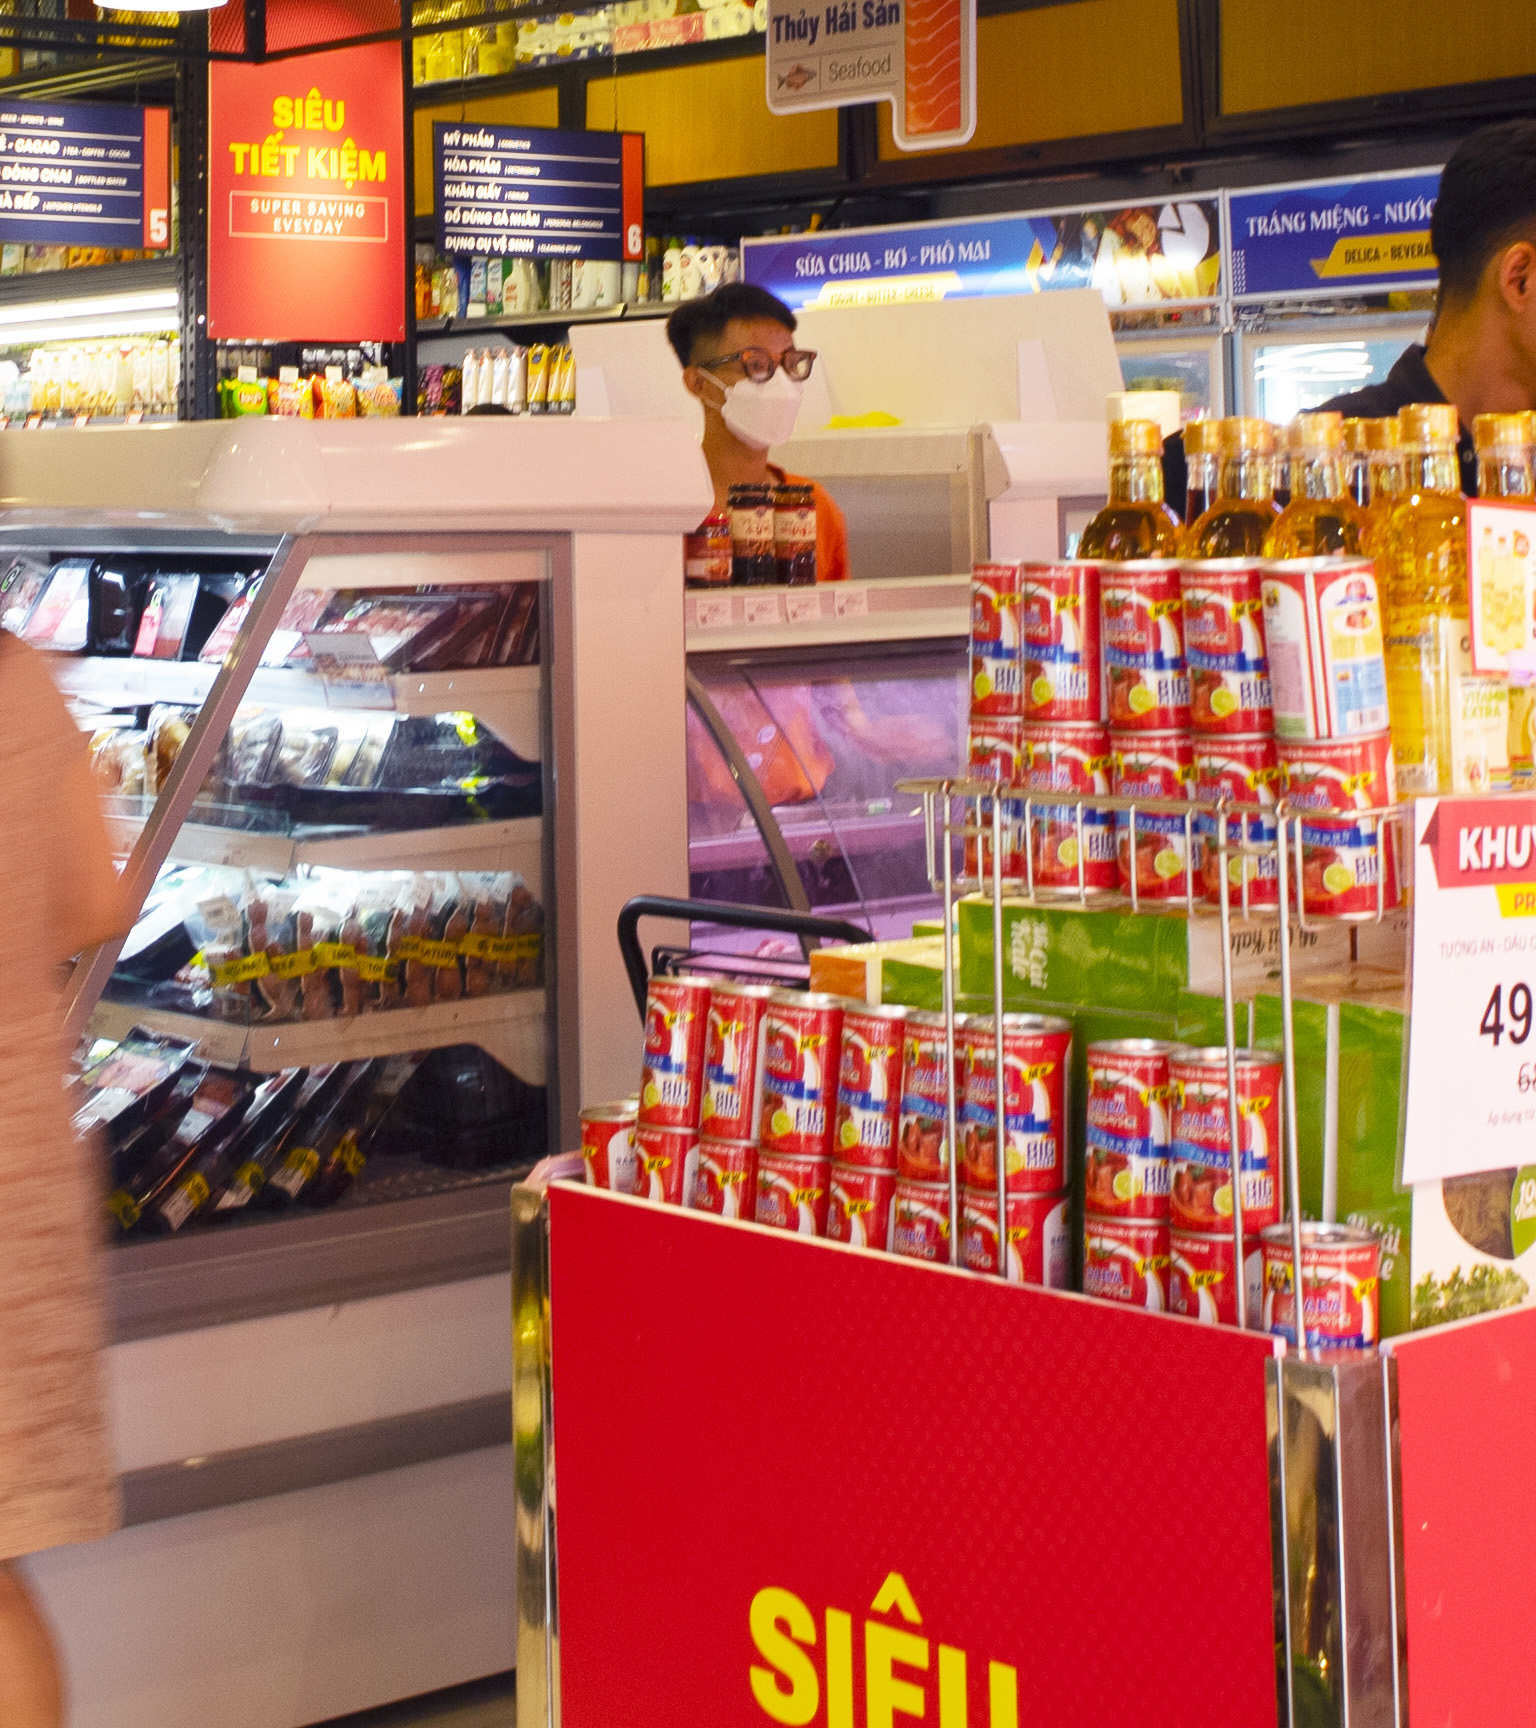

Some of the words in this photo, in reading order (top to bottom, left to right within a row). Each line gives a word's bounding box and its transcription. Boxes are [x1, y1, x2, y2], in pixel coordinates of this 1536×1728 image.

[773, 9, 820, 47] Thủy
[828, 53, 891, 82] Seafood
[272, 88, 346, 132] SIÊU
[15, 138, 60, 156] CACAO
[228, 130, 300, 176] TIẾT
[306, 137, 386, 190] KIỆM
[2, 163, 39, 183] ĐÓNG
[40, 168, 72, 185] CHAI
[14, 190, 41, 211] BẾP
[249, 199, 302, 216] SUPER
[308, 201, 366, 220] SAVING
[149, 208, 168, 243] 5
[273, 216, 344, 236] EVEYDAY
[1246, 204, 1308, 238] TRÁNG
[1310, 198, 1370, 237] MIỆNG
[627, 224, 642, 255] 6
[1343, 244, 1383, 265] DELICA
[795, 244, 826, 278] SỮA
[828, 246, 871, 274] CHUA
[884, 243, 908, 269] BƠ
[920, 238, 955, 266] PHÔ
[957, 239, 992, 264] MAI
